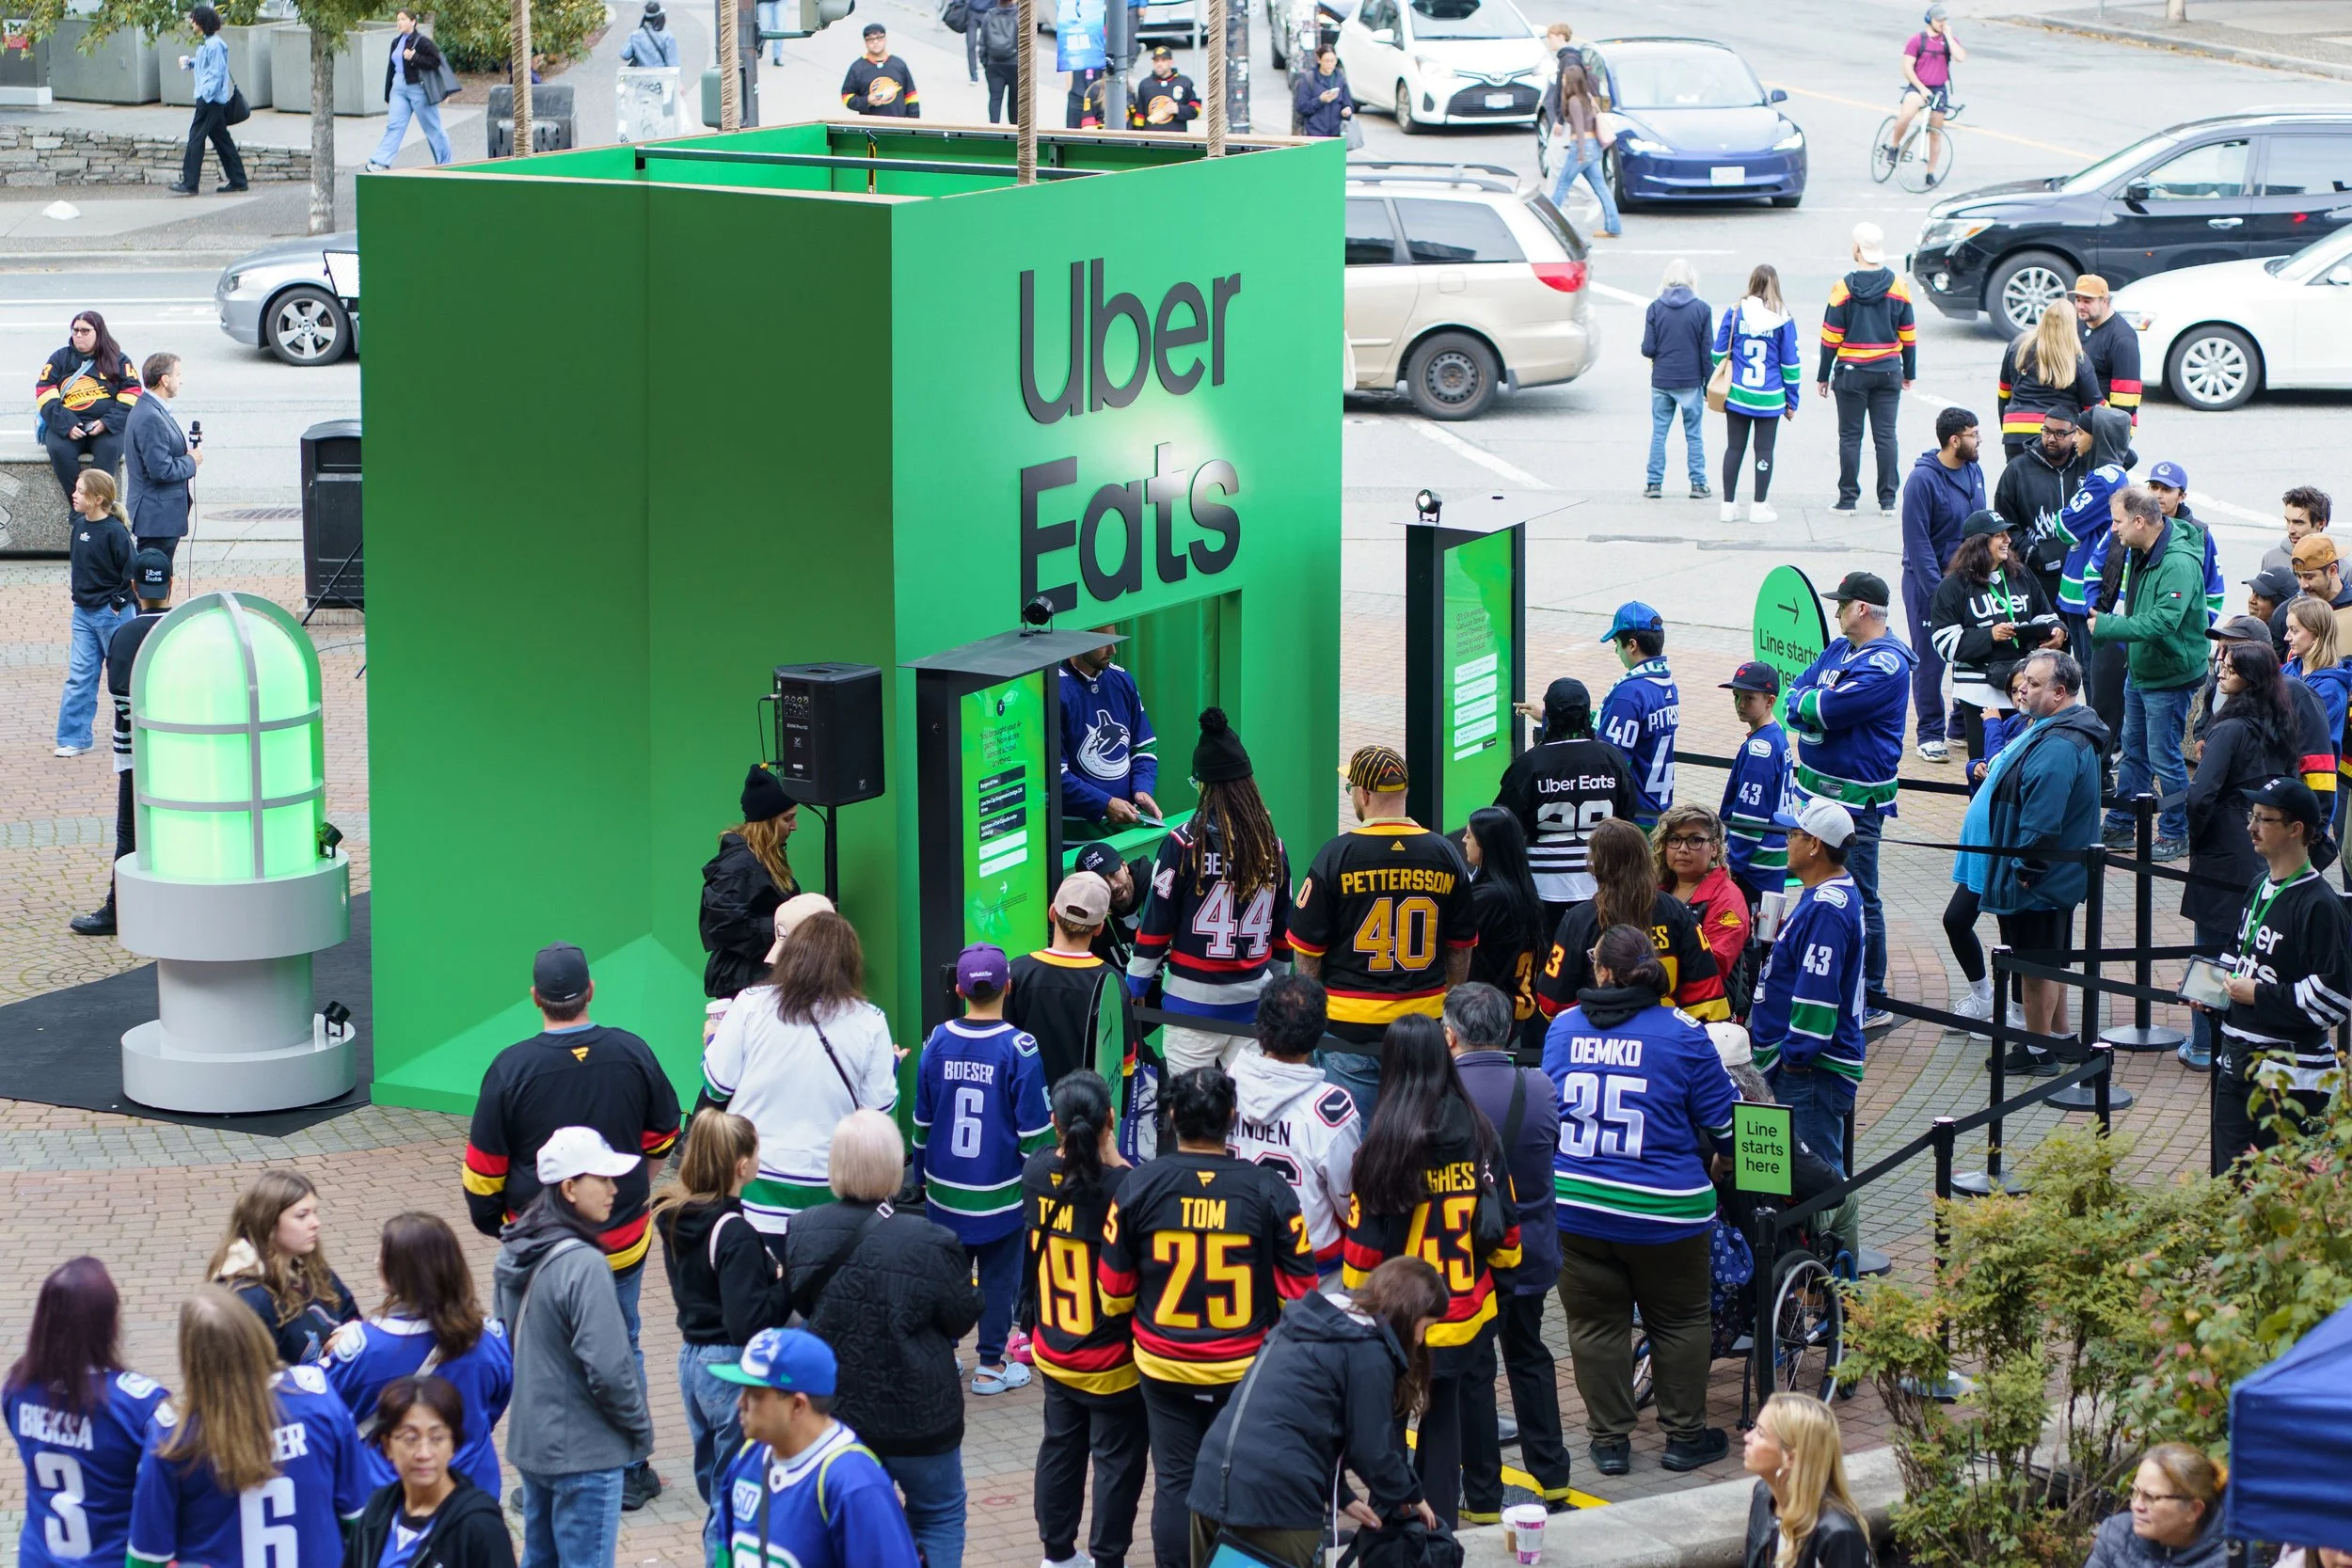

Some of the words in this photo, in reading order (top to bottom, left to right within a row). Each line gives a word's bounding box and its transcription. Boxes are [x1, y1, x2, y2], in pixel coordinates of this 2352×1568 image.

[1020, 258, 1241, 424] Uber
[1741, 339, 1768, 388] 3
[1021, 442, 1240, 623] Eats
[1970, 593, 2029, 619] Uber
[1759, 628, 1784, 656] Line
[1787, 637, 1819, 666] starts
[1605, 716, 1639, 750] 40
[1537, 778, 1577, 794] Uber
[1579, 775, 1615, 793] Eats
[1645, 735, 1676, 806] 4
[1739, 782, 1762, 806] 43
[1082, 851, 1099, 865] Uber
[1086, 857, 1104, 871] Eats
[1342, 869, 1454, 895] PETTERSSON
[1192, 880, 1277, 958] 44
[1354, 896, 1439, 972] 40
[2238, 907, 2283, 955] Uer
[1803, 943, 1834, 976] 43
[945, 1060, 994, 1085] BOESER
[1570, 1037, 1643, 1067] DEMKO
[951, 1086, 984, 1158] 6
[1559, 1071, 1647, 1159] 35
[1747, 1120, 1777, 1137] Line
[1741, 1139, 1784, 1157] starts
[1745, 1157, 1780, 1174] here
[1103, 1200, 1119, 1244] 5
[1181, 1197, 1227, 1229] TOM
[1289, 1214, 1312, 1255] 2
[1403, 1197, 1477, 1292] 43
[1032, 1229, 1093, 1337] 19
[1152, 1229, 1252, 1329] 25
[19, 1402, 94, 1450] BIEKSA
[34, 1451, 92, 1560] 3
[240, 1476, 298, 1568] 6
